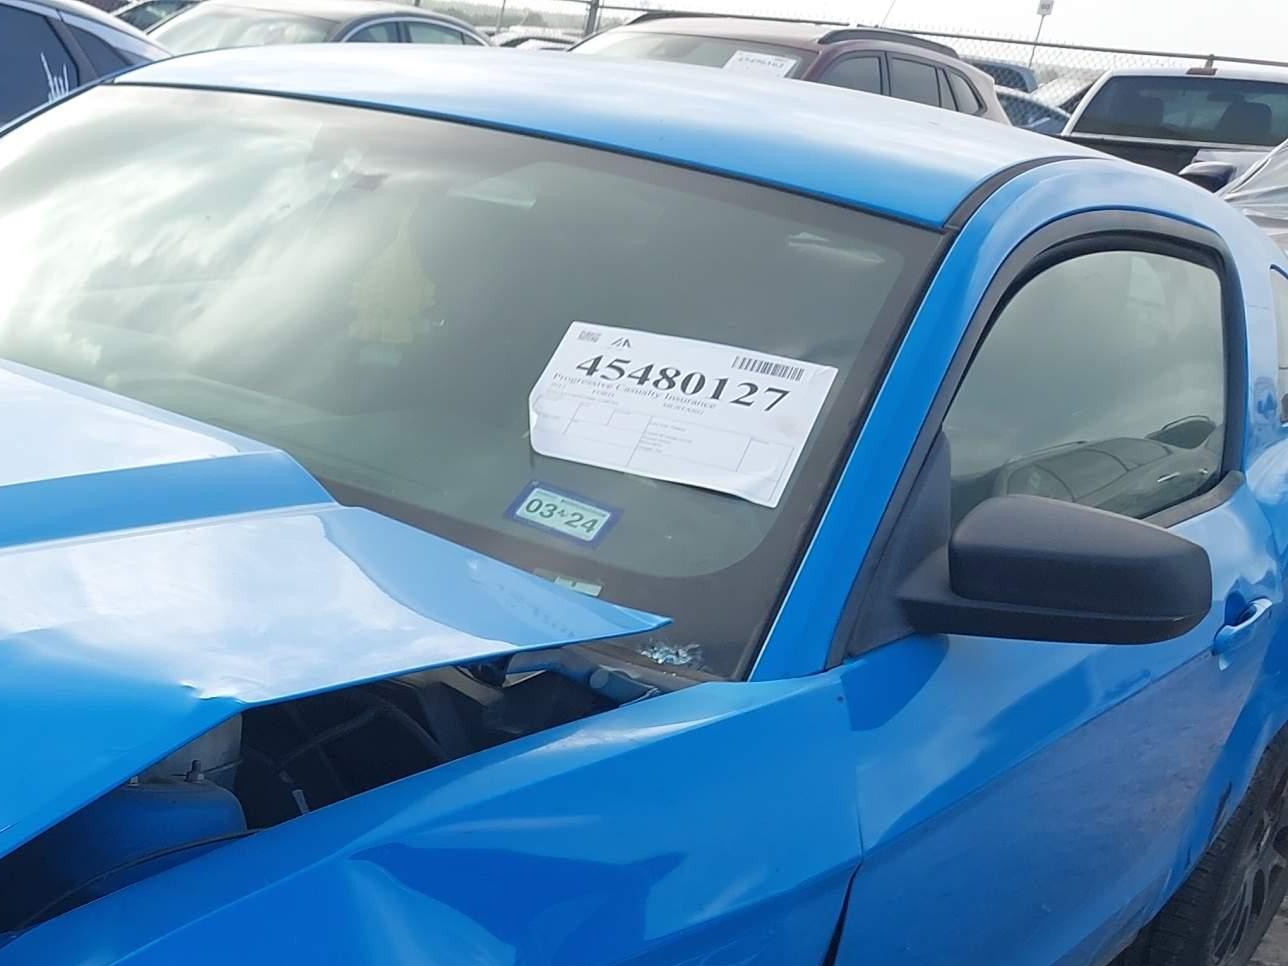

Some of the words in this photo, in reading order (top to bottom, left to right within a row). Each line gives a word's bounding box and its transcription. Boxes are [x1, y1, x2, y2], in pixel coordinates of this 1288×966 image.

[552, 372, 614, 390] Progressive
[615, 383, 661, 400] Casualty
[664, 392, 717, 410] Insurance
[575, 354, 790, 412] 45480127
[525, 498, 558, 519] 03
[564, 511, 600, 534] 24
